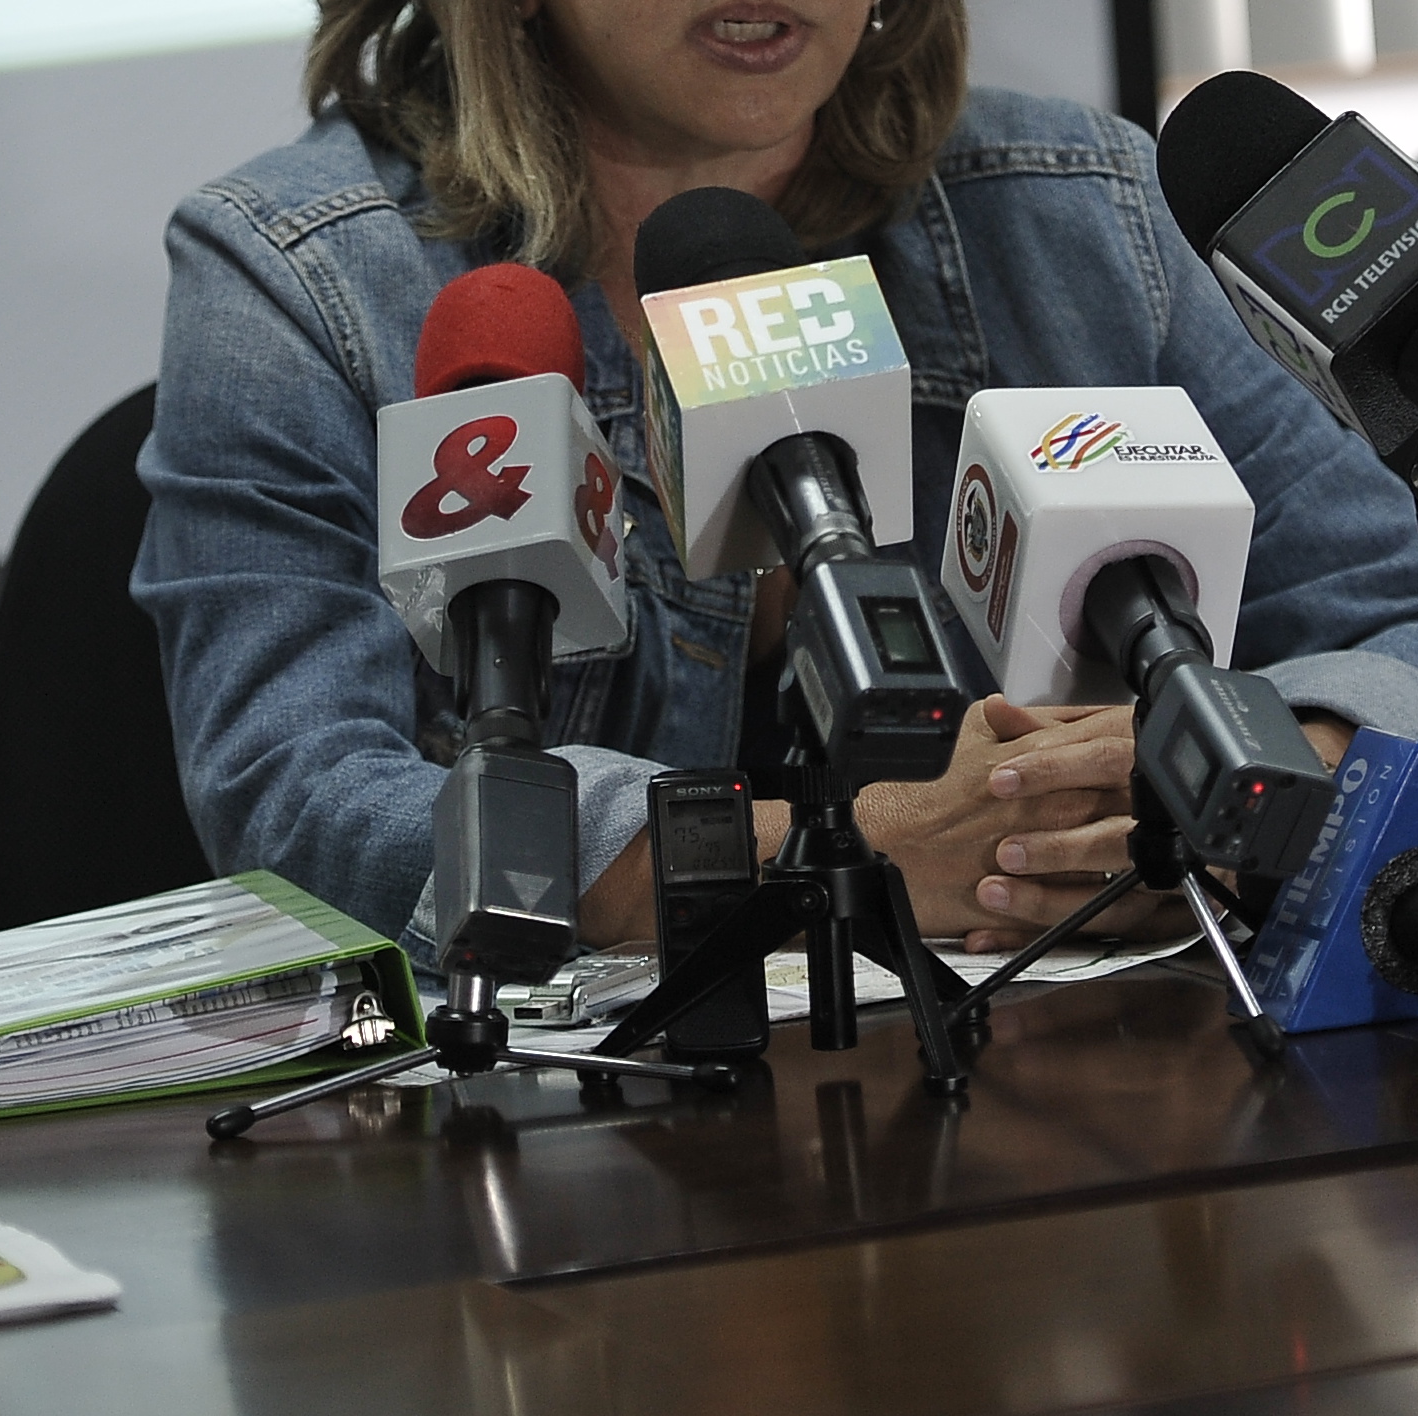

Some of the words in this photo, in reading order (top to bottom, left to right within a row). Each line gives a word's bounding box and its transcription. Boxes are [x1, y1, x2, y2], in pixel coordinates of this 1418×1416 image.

[679, 277, 855, 366] RED
[1321, 287, 1359, 325] RCN
[701, 338, 869, 392] NOTICIAS
[1113, 444, 1205, 456] EJECUTAR
[1137, 454, 1184, 462] NUESTRA
[1187, 454, 1219, 462] RUTA
[676, 786, 723, 797] SONY
[1247, 946, 1284, 998] EL
[1271, 758, 1368, 931] TIEMPO
